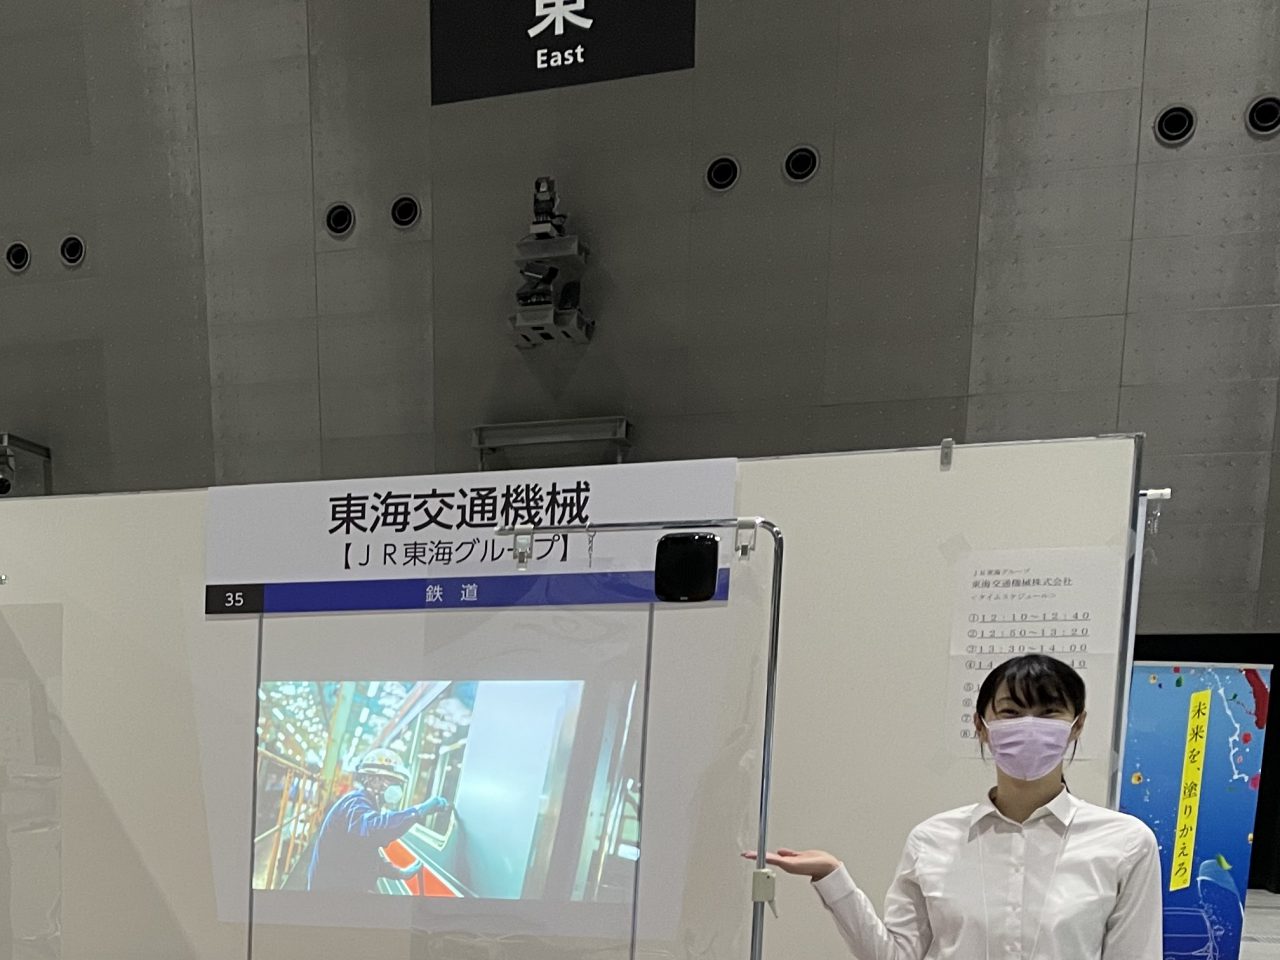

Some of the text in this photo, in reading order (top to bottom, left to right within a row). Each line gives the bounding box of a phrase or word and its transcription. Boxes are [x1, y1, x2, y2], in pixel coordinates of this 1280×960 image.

[536, 44, 585, 69] East
[328, 480, 591, 535] 東海交通機械
[224, 592, 245, 607] 35
[1174, 700, 1208, 884] 未来を、塗りかえろ。
